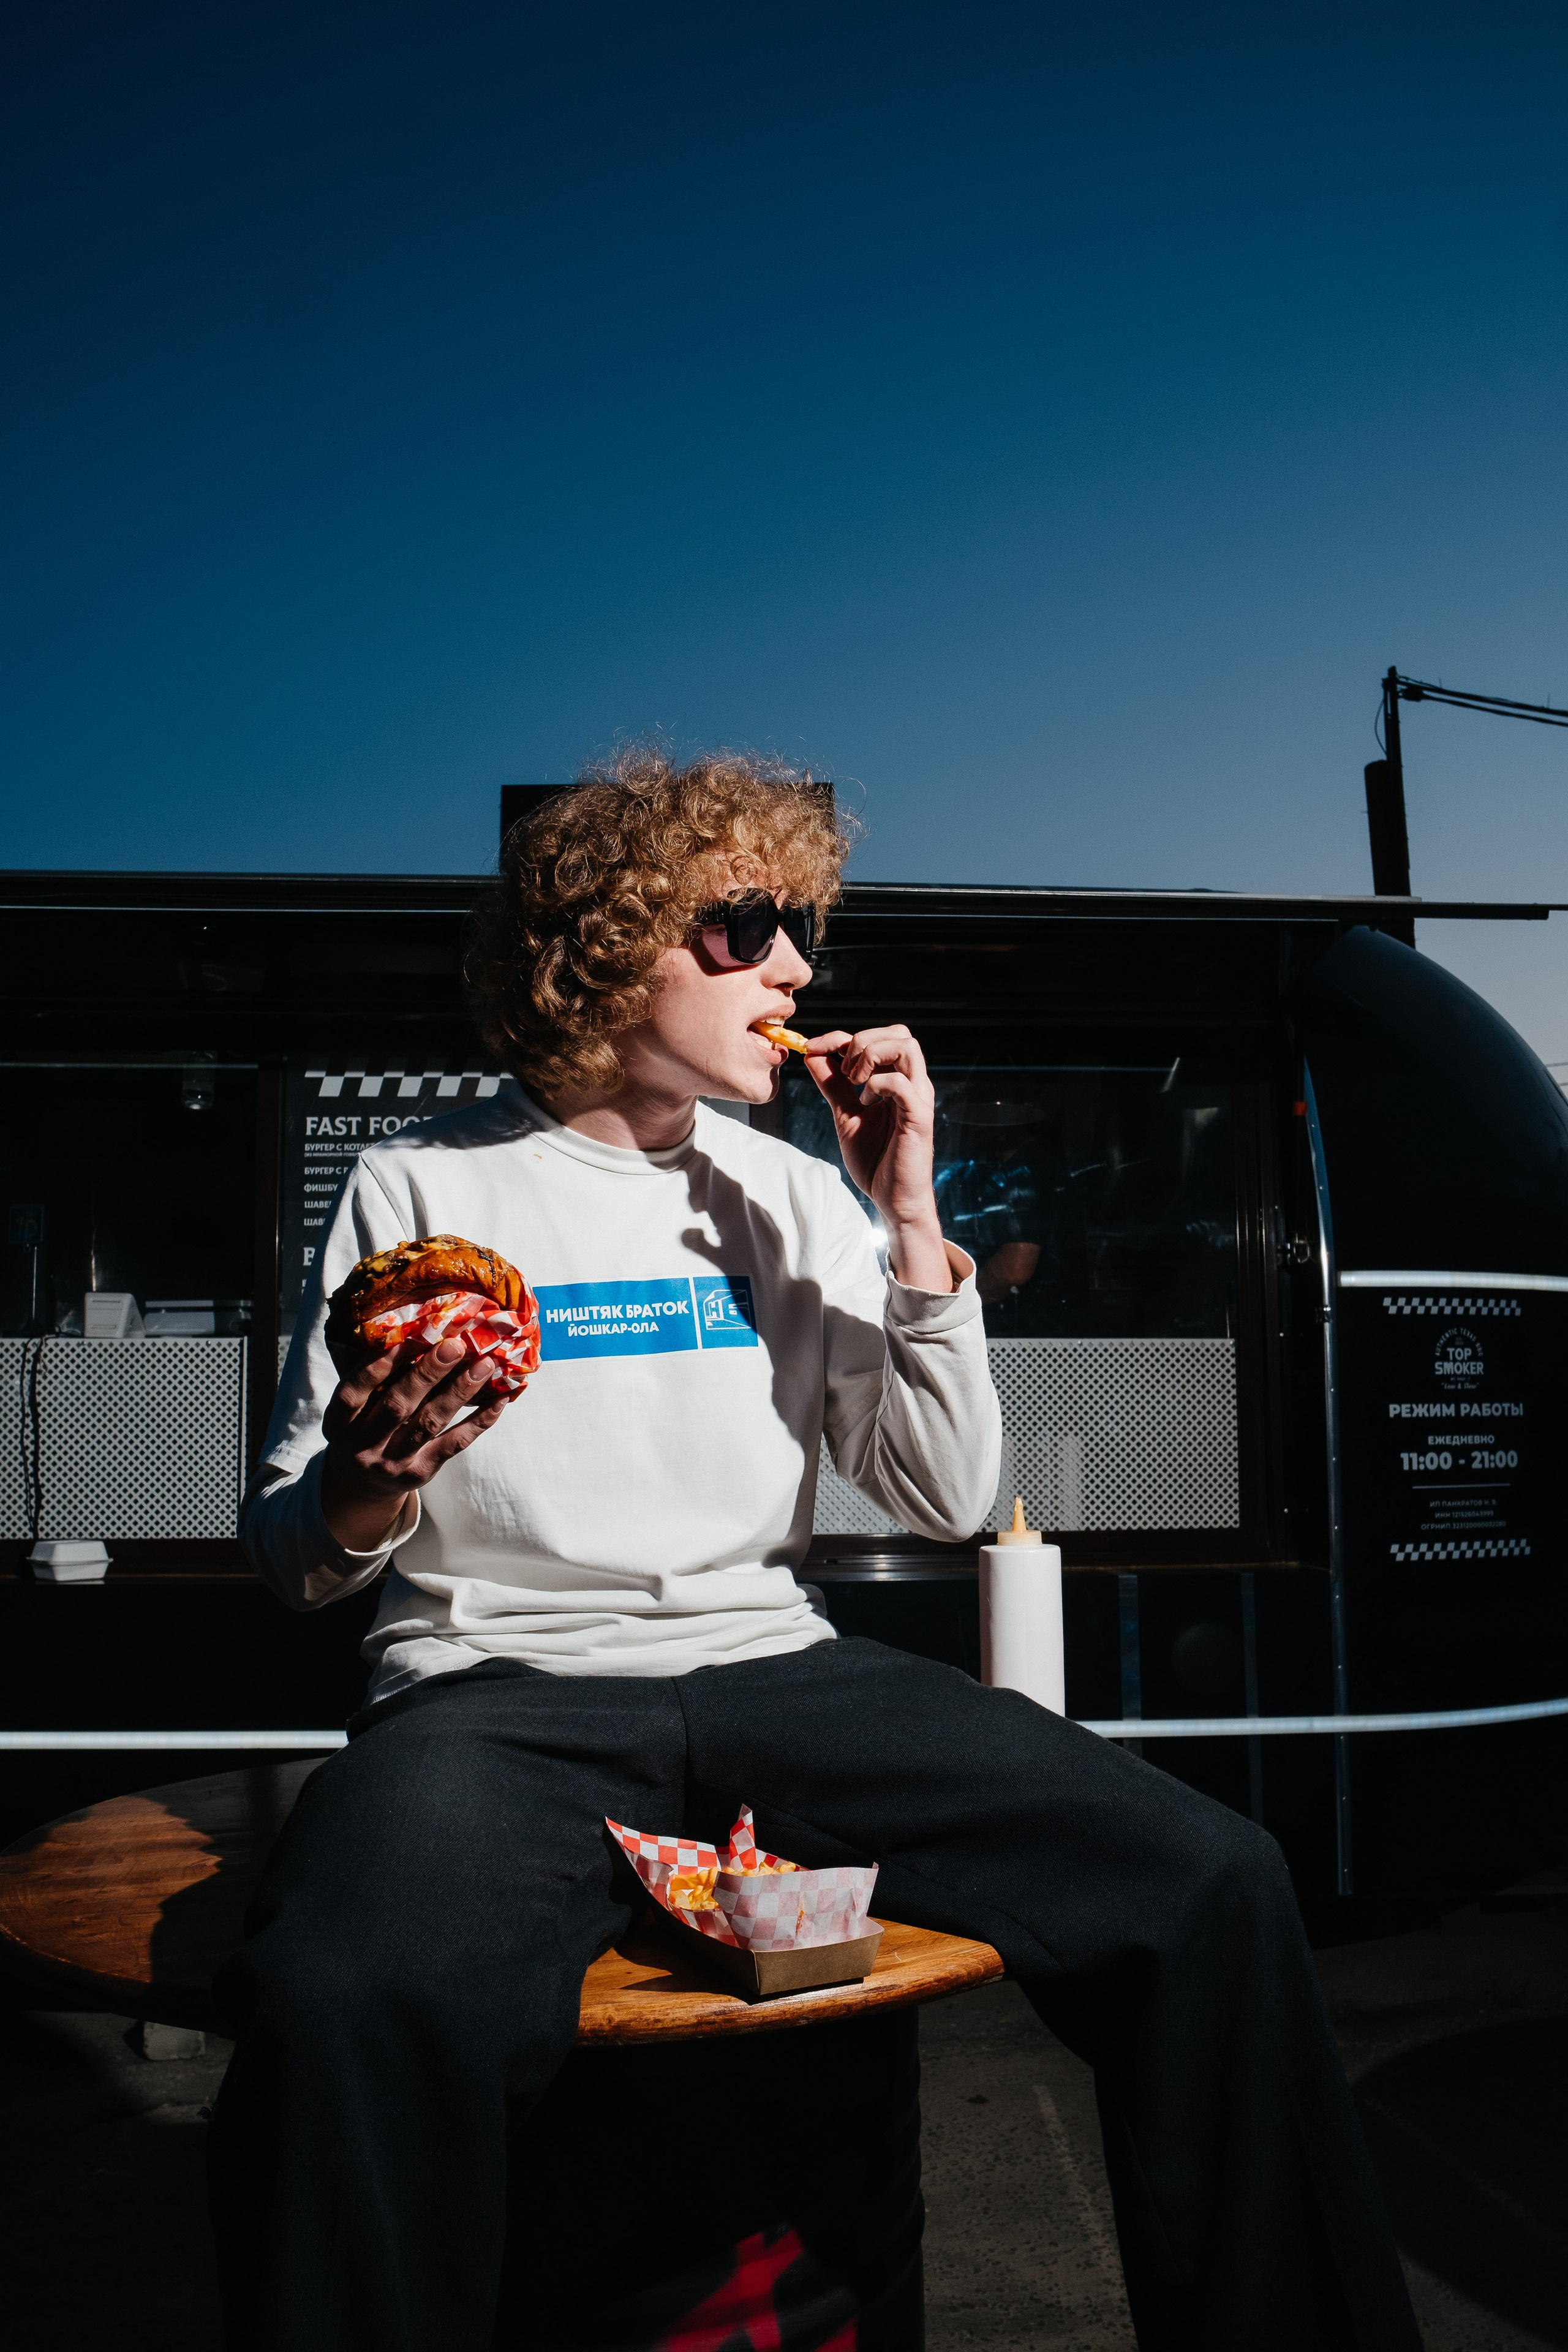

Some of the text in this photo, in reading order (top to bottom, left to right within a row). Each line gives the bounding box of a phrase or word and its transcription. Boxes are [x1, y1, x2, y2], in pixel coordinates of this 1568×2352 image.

[305, 1115, 434, 1136] FAST FO
[304, 1142, 334, 1152] БУРГЕР
[336, 1142, 342, 1152] С
[546, 1300, 690, 1324] НИШТЯК БРАТОК
[567, 1321, 660, 1337] ЙОШКАР-ОЛА
[1447, 1348, 1472, 1360] TOP
[1434, 1362, 1484, 1375] SMOKER
[1389, 1403, 1523, 1418] РЕЖИМ РАБОТЫ
[1428, 1434, 1494, 1446] ЕЖЕДНЕВНО
[1400, 1452, 1452, 1471] 11:00
[1471, 1450, 1518, 1469] 21:00
